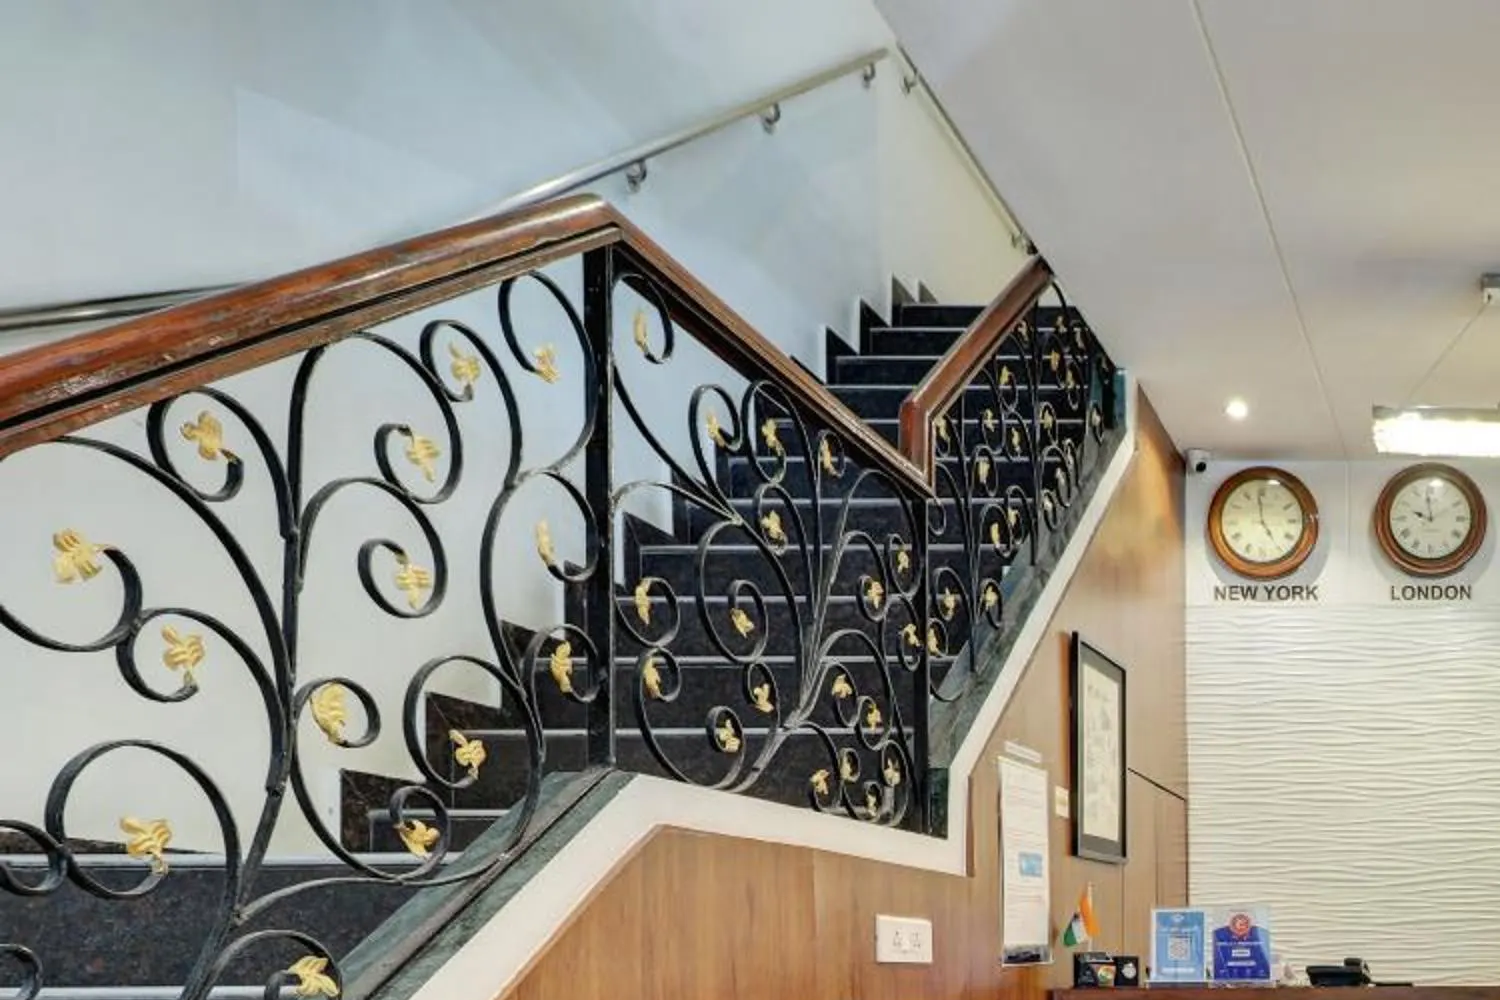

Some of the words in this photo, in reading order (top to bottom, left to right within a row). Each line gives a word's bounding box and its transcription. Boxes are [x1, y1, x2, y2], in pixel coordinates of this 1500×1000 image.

[1213, 585, 1257, 601] NEW
[1264, 585, 1319, 601] YORK
[1390, 585, 1472, 601] LONDON
